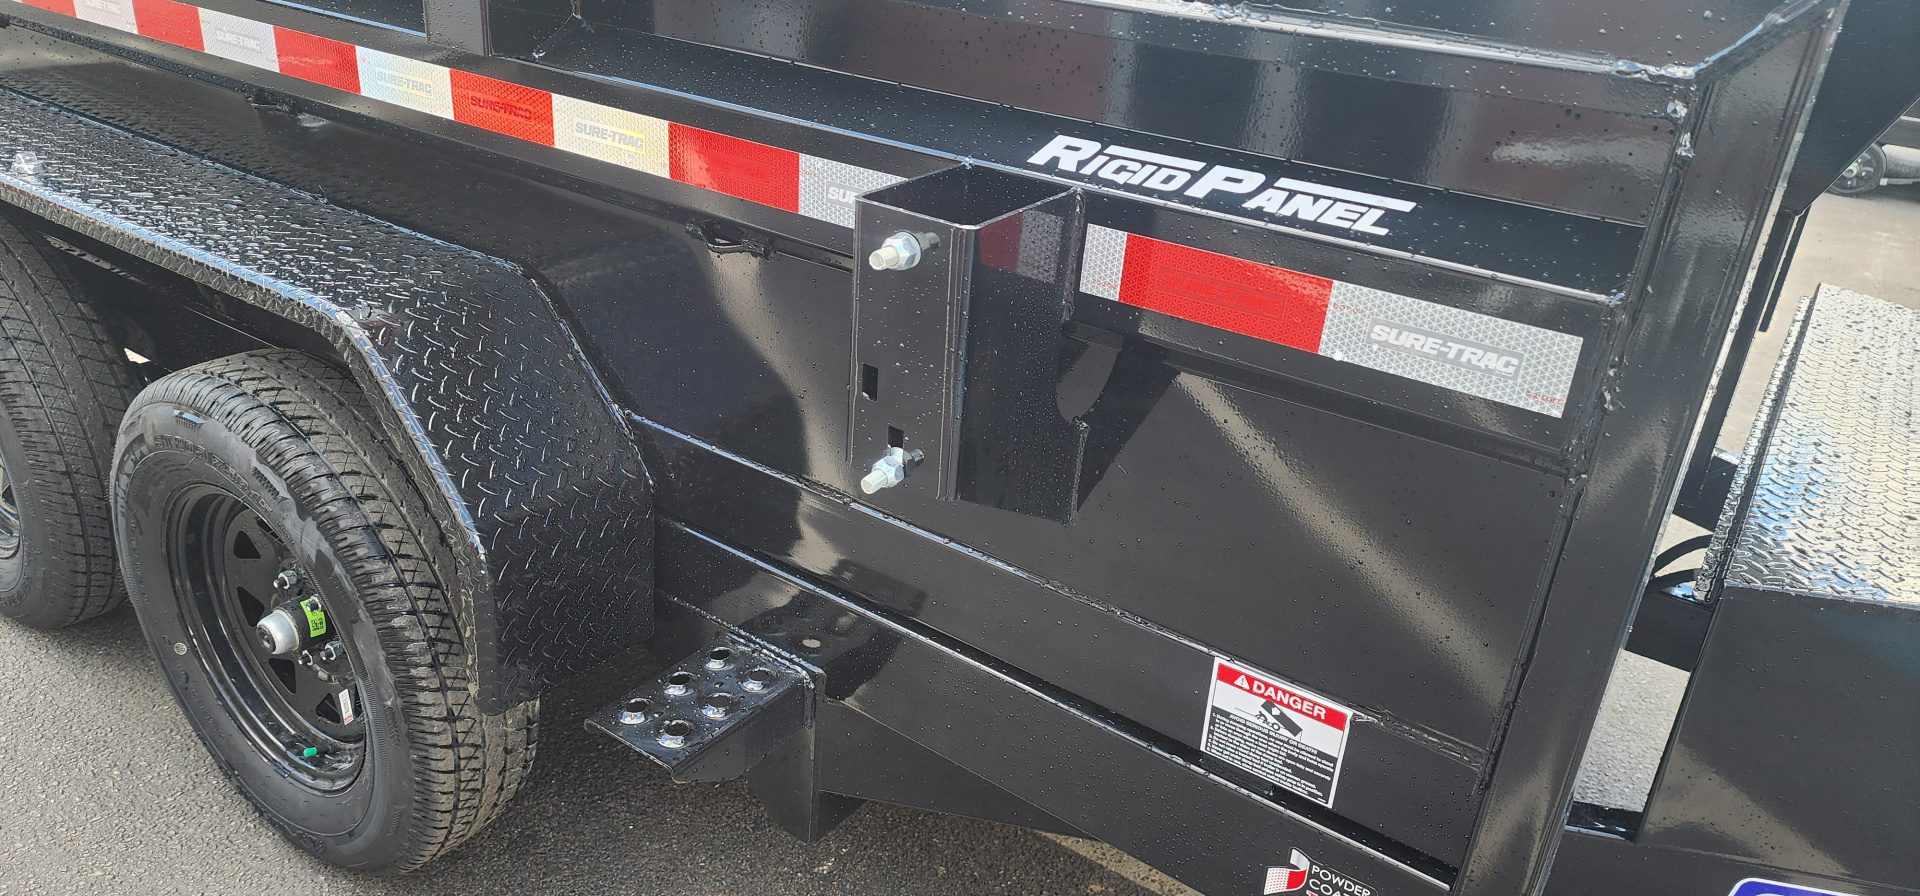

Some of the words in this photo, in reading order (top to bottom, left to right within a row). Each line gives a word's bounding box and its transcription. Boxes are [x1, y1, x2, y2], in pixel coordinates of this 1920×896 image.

[215, 30, 261, 51] SURE-TRAC
[376, 71, 432, 96] SURE-TRAC
[470, 95, 532, 121] SURE-TRAC
[575, 121, 645, 150] SURE-TRAC
[1027, 135, 1200, 192] RIGID
[1184, 165, 1390, 236] PANEL
[1159, 271, 1284, 317] SURE-TRAC
[1370, 324, 1519, 376] SURE-TRAC
[1252, 681, 1327, 720] DANGER
[1311, 865, 1371, 896] POWDER
